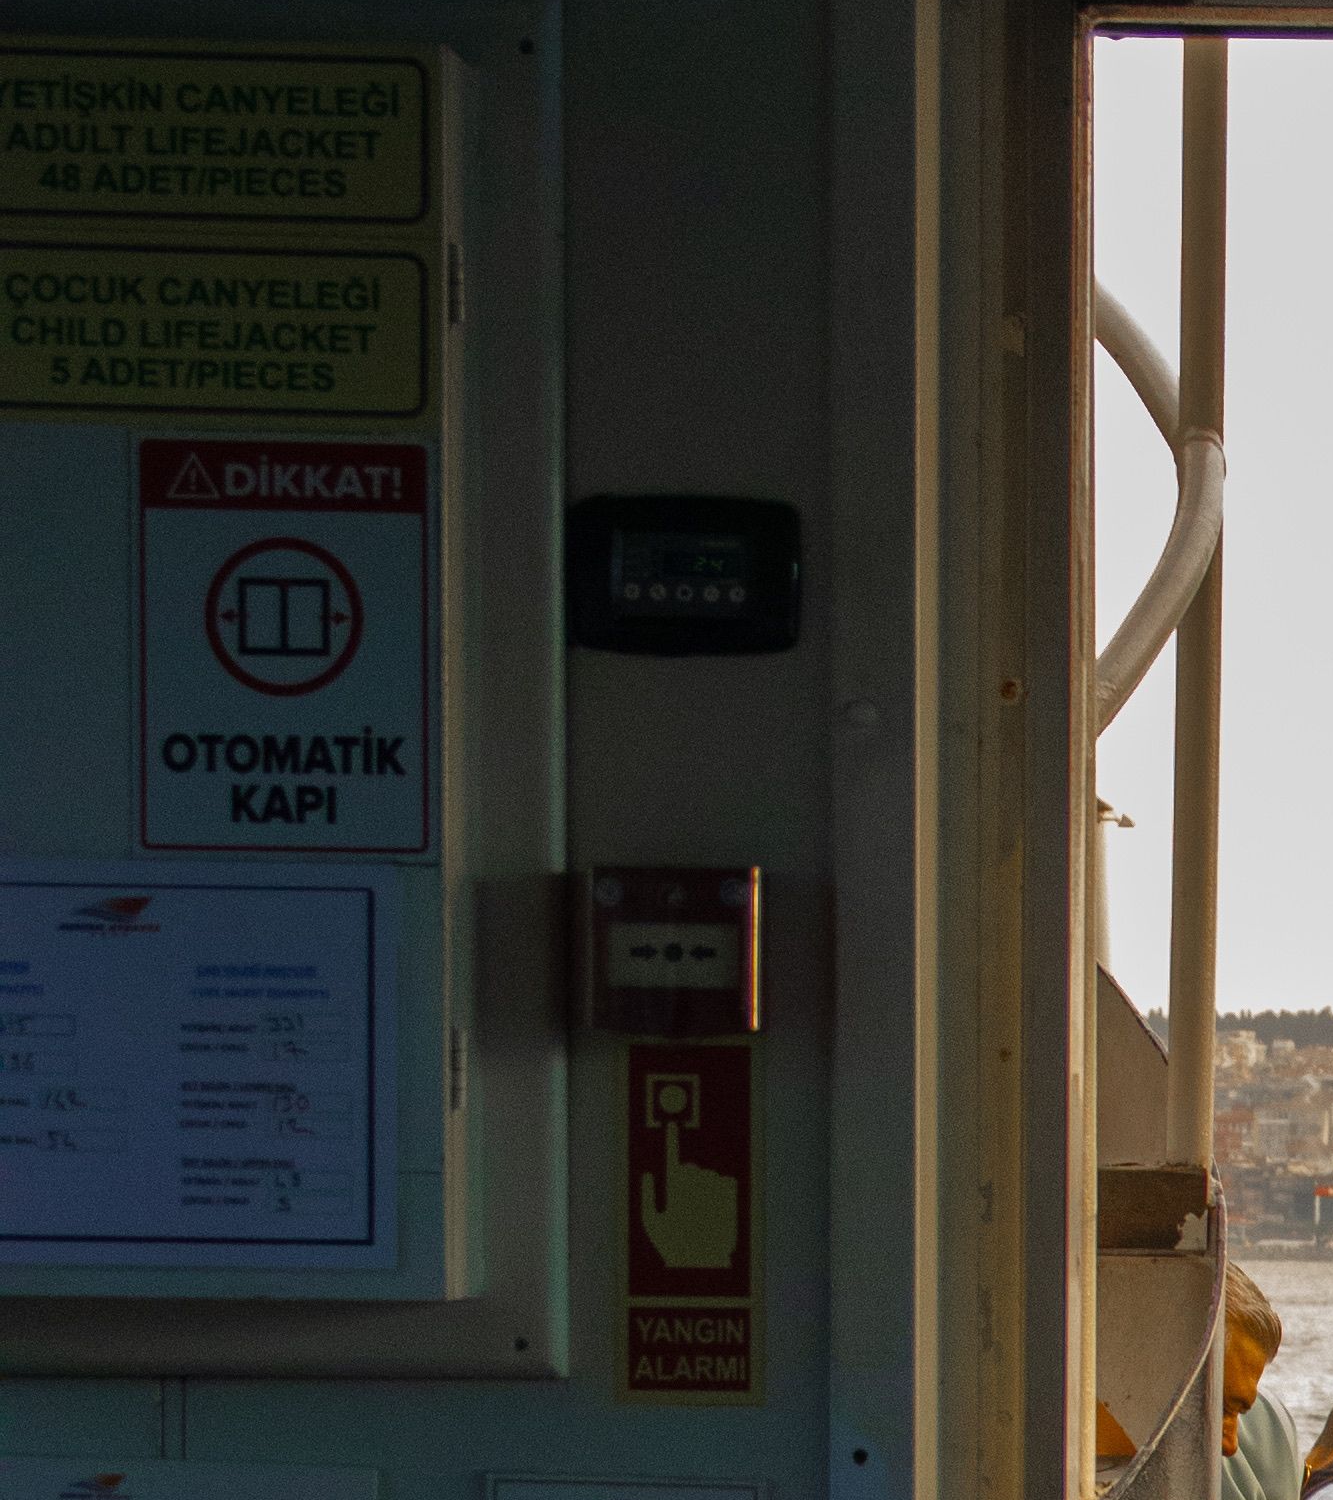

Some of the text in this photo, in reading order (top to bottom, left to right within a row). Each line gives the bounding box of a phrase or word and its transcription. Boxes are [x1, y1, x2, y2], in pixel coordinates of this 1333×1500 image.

[176, 79, 399, 117] CANYELEĞİ
[6, 123, 380, 160] ADULT LIFEJACKET
[39, 164, 347, 198] 48 ADET/PIECES
[4, 273, 381, 311] ÇOCUK CANYELEĞİ
[11, 316, 376, 354] CHILD LIFEJACKET
[51, 357, 335, 391] 5 ADET/PIECES
[224, 459, 403, 500] DİKKAT!
[162, 727, 406, 776] OTOMATİK
[231, 784, 338, 825] KAPI
[636, 1317, 744, 1344] YANGIN
[634, 1352, 745, 1382] ALARMI
